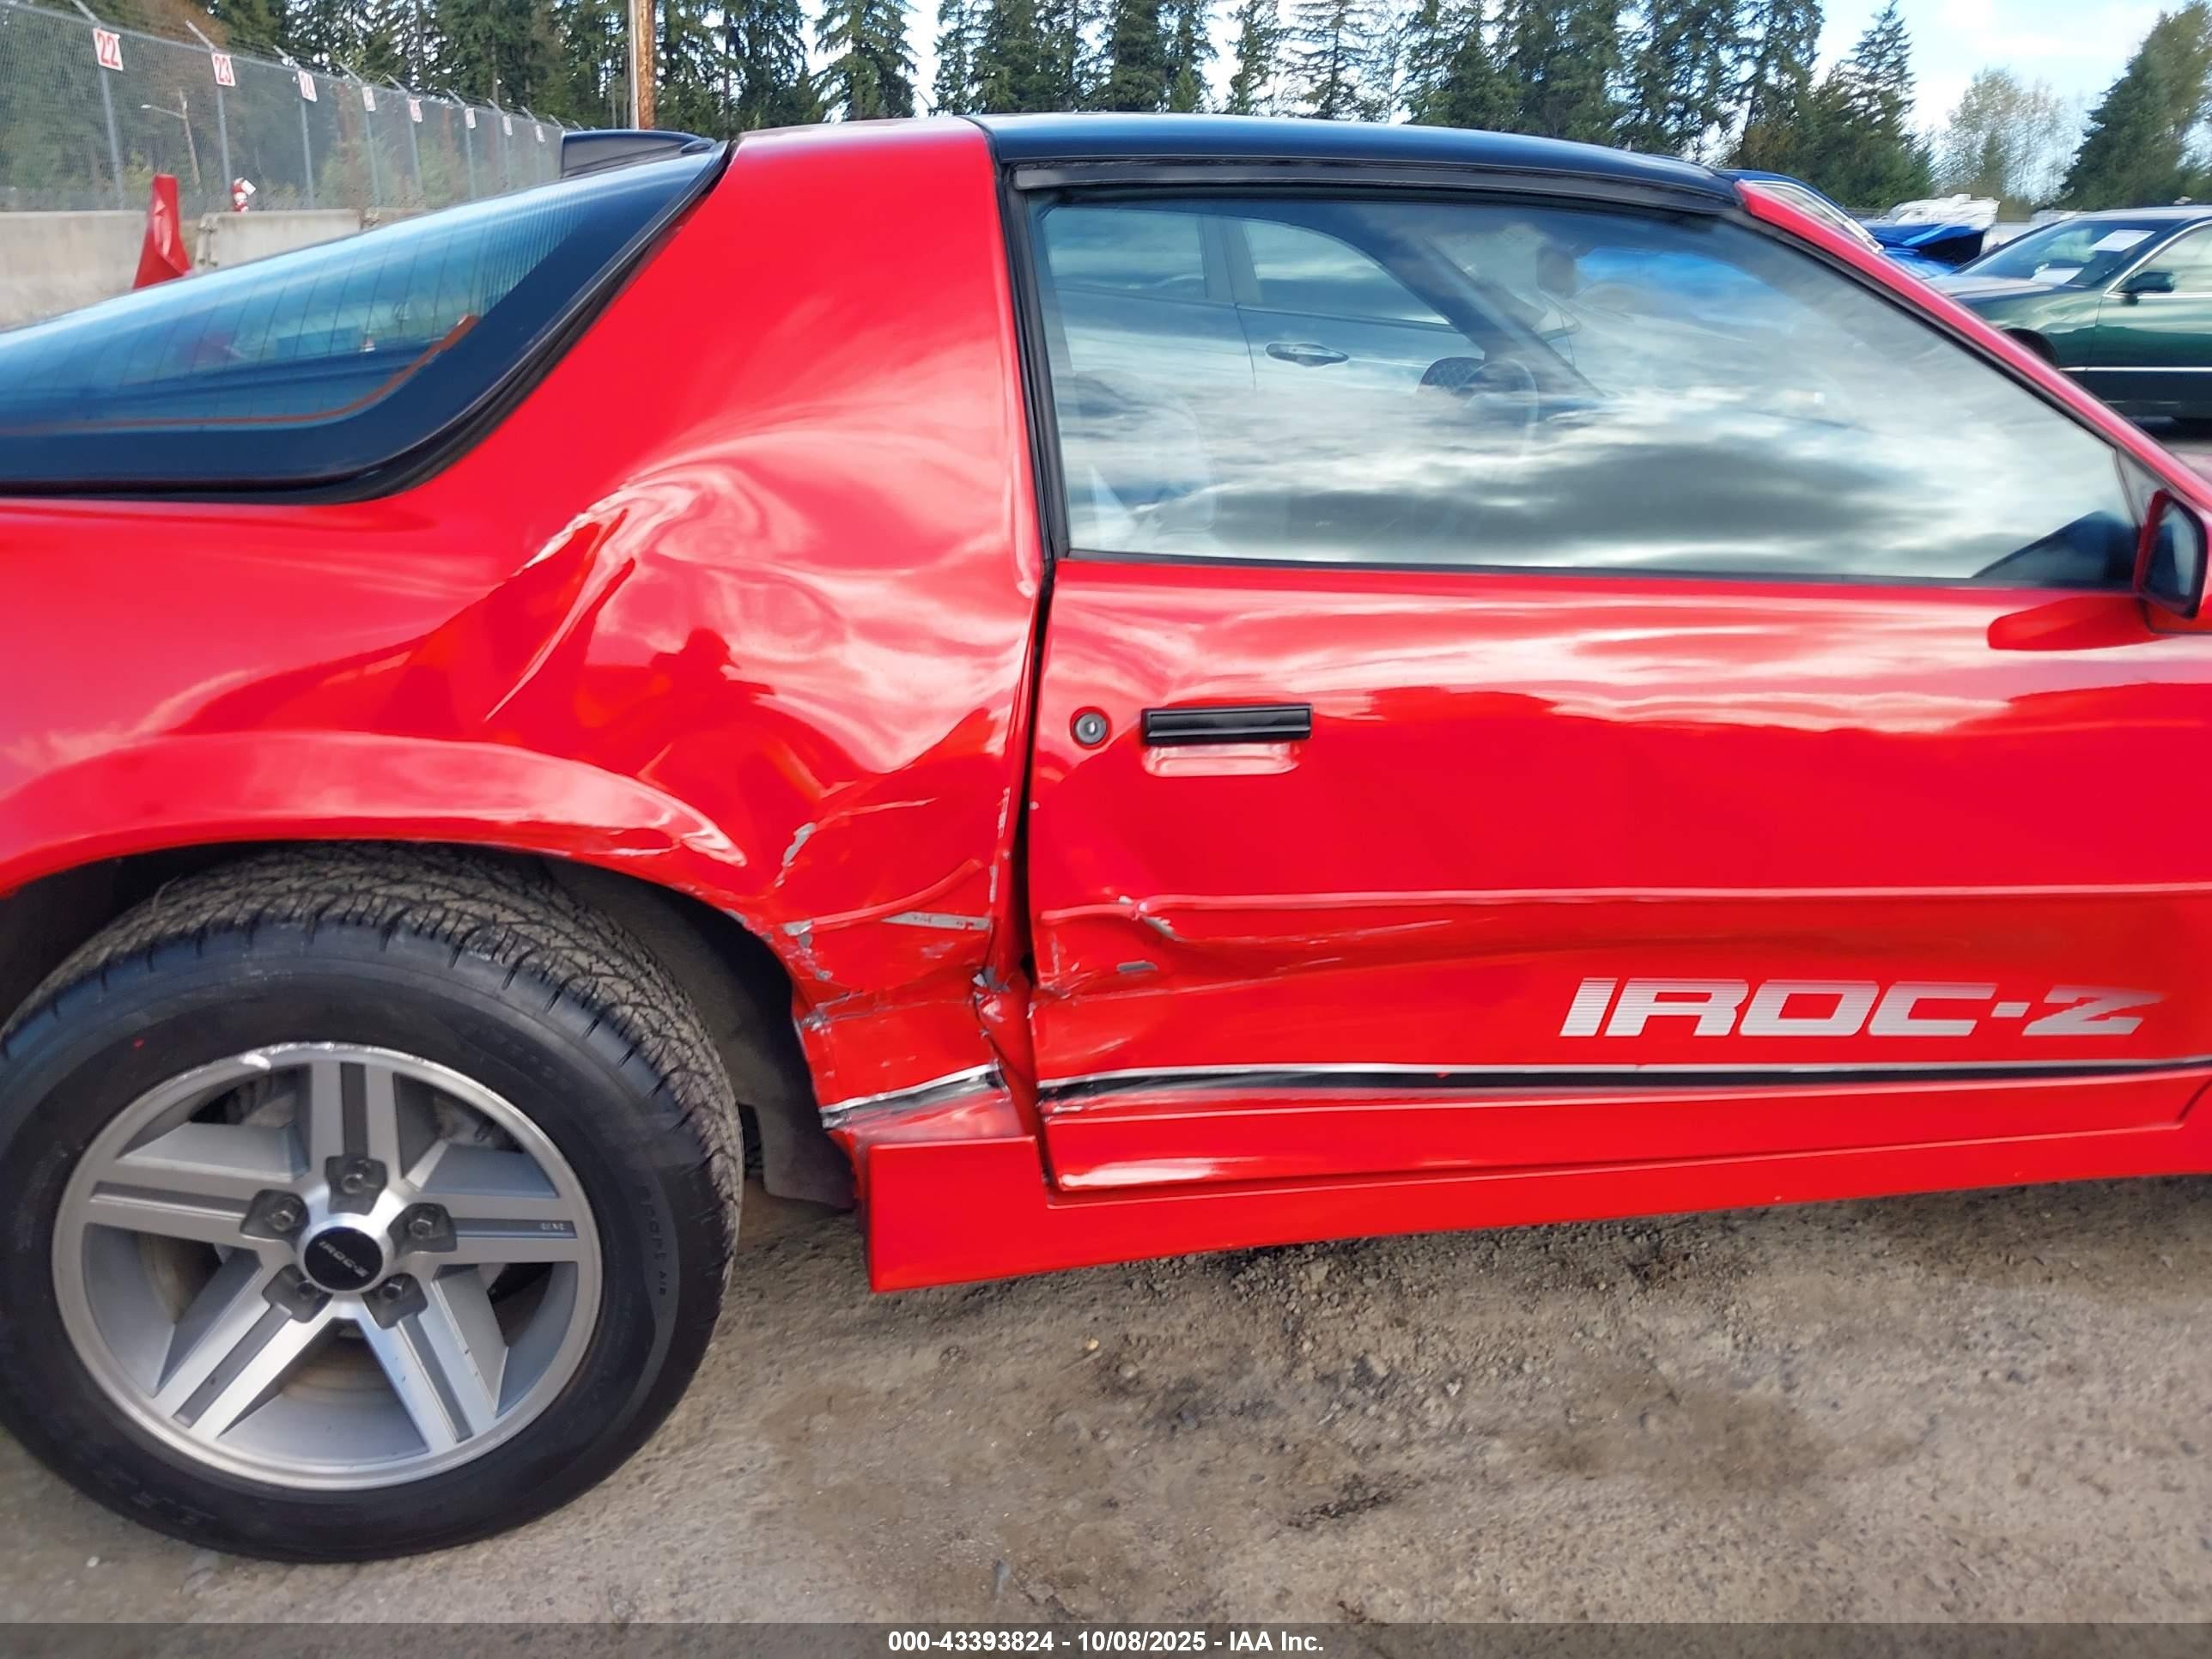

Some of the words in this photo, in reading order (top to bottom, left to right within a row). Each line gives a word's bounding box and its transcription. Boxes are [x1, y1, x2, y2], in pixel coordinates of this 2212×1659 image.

[96, 31, 119, 67] 22
[214, 55, 232, 83] 23
[1559, 977, 2167, 1037] IROC-Z
